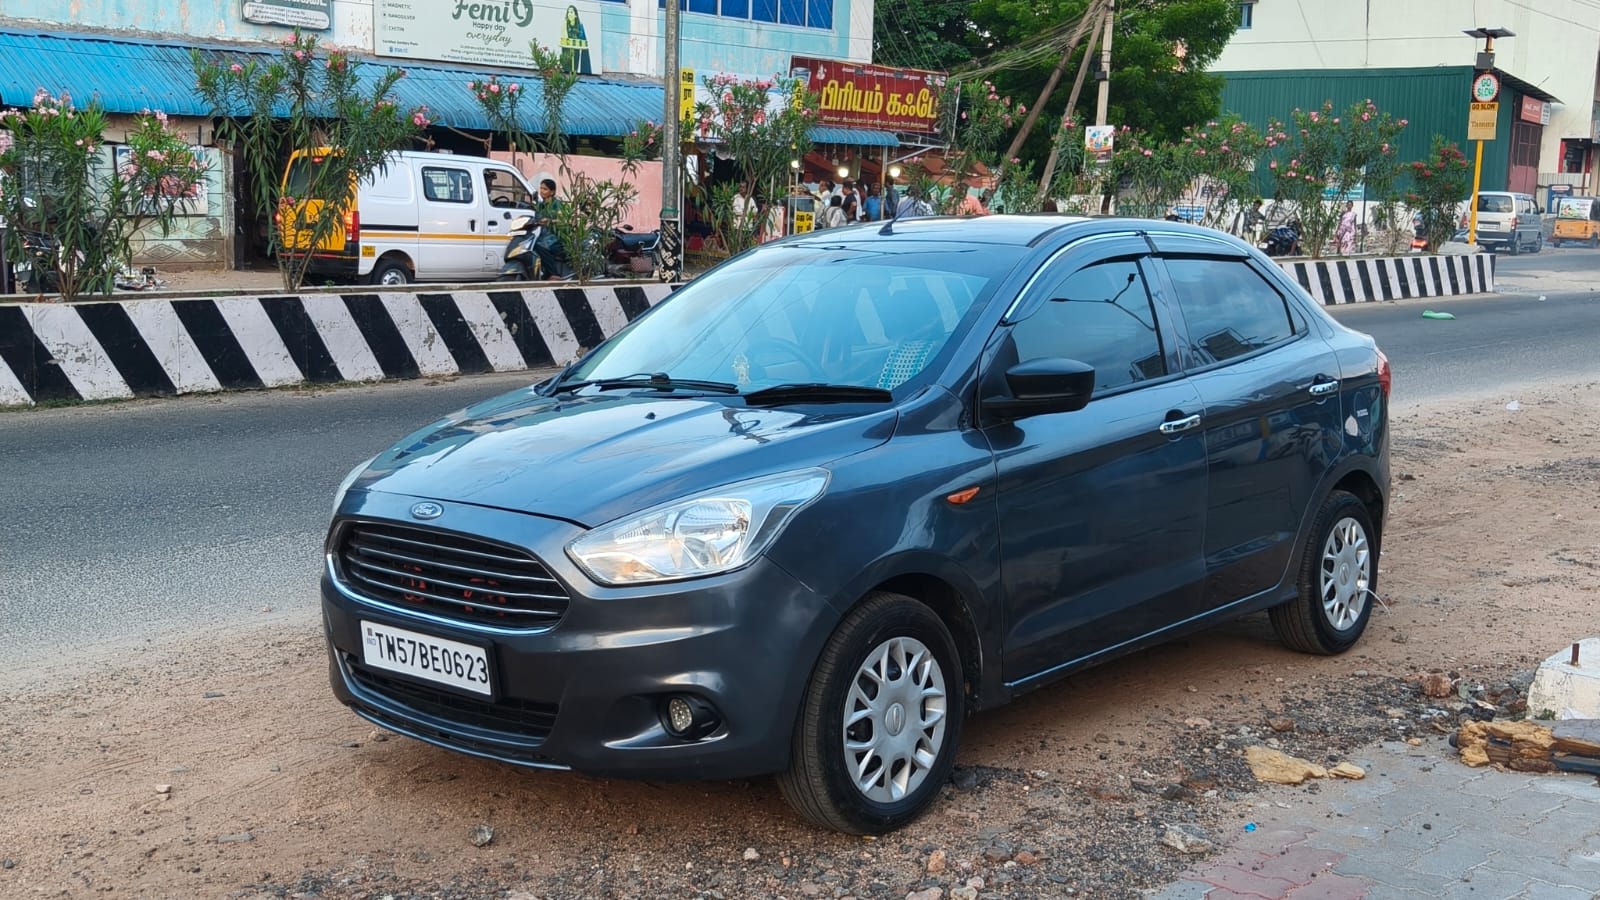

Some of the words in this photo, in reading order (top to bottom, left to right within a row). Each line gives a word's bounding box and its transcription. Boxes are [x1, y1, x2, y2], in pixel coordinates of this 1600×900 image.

[473, 21, 493, 31] Happy
[494, 23, 506, 32] day
[1482, 78, 1491, 87] GO
[820, 79, 883, 113] பிரியம்
[375, 632, 488, 684] TN57BE0623
